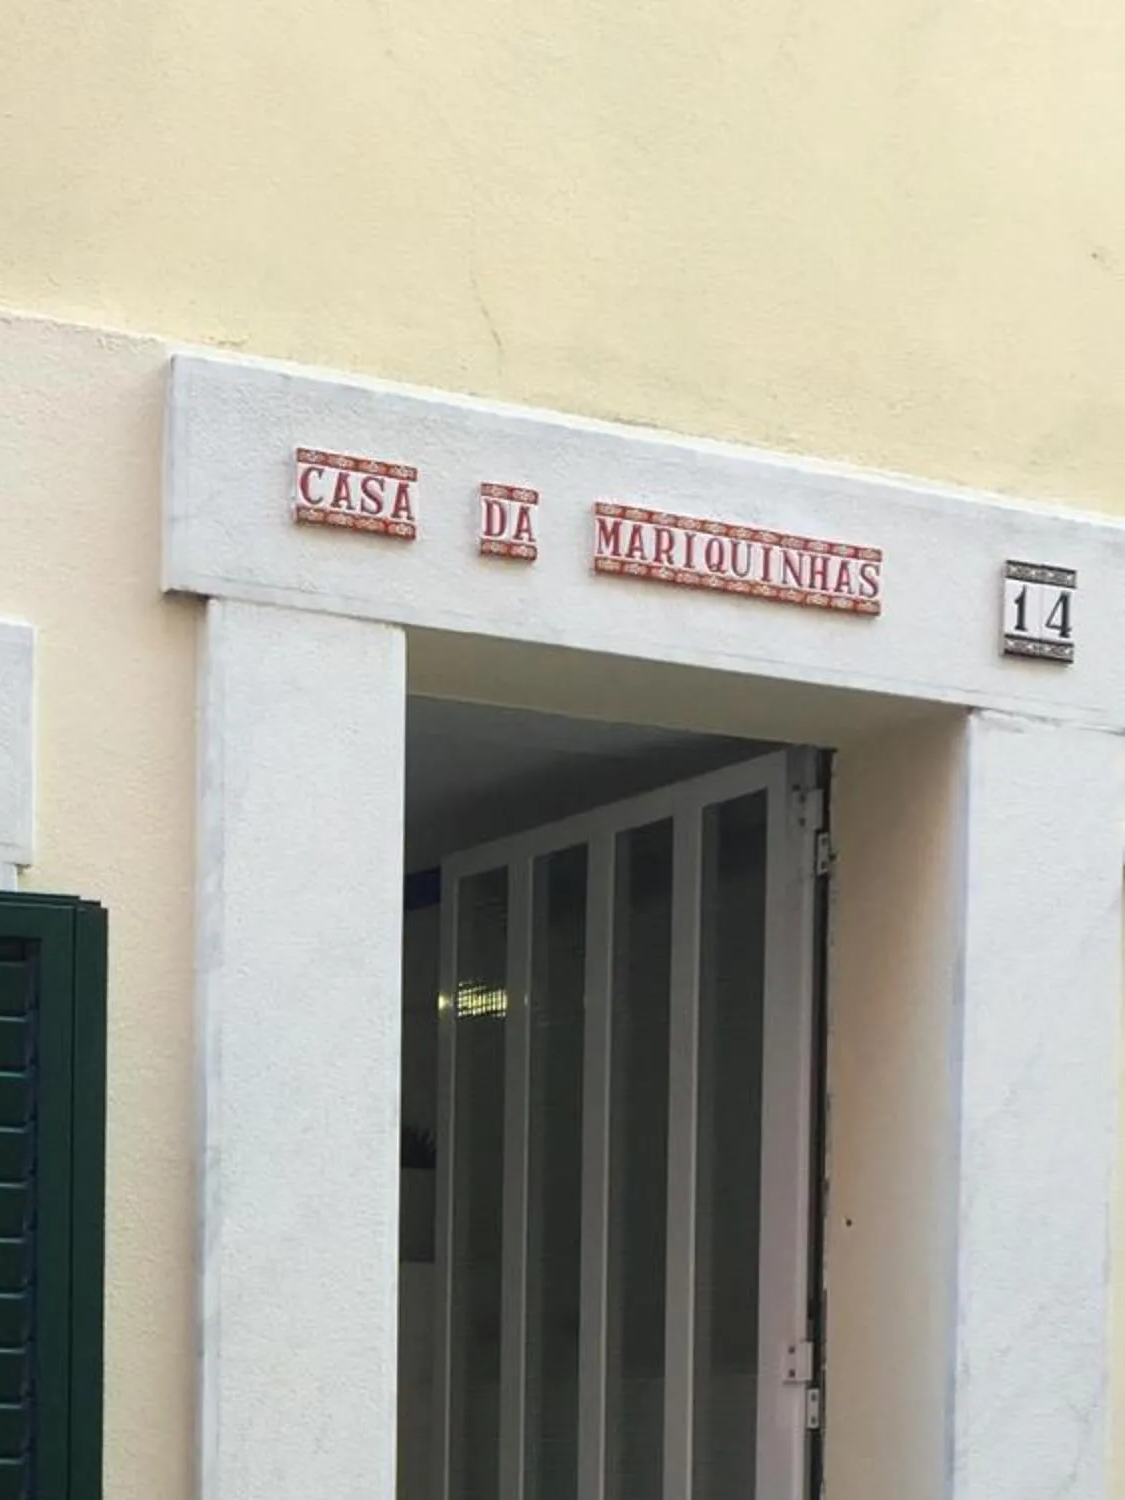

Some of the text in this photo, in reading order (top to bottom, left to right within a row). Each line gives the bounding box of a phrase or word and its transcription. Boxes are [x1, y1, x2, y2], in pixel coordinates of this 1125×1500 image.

[299, 466, 880, 597] CASA DA MARIQUINHAS
[1013, 584, 1073, 639] 14
